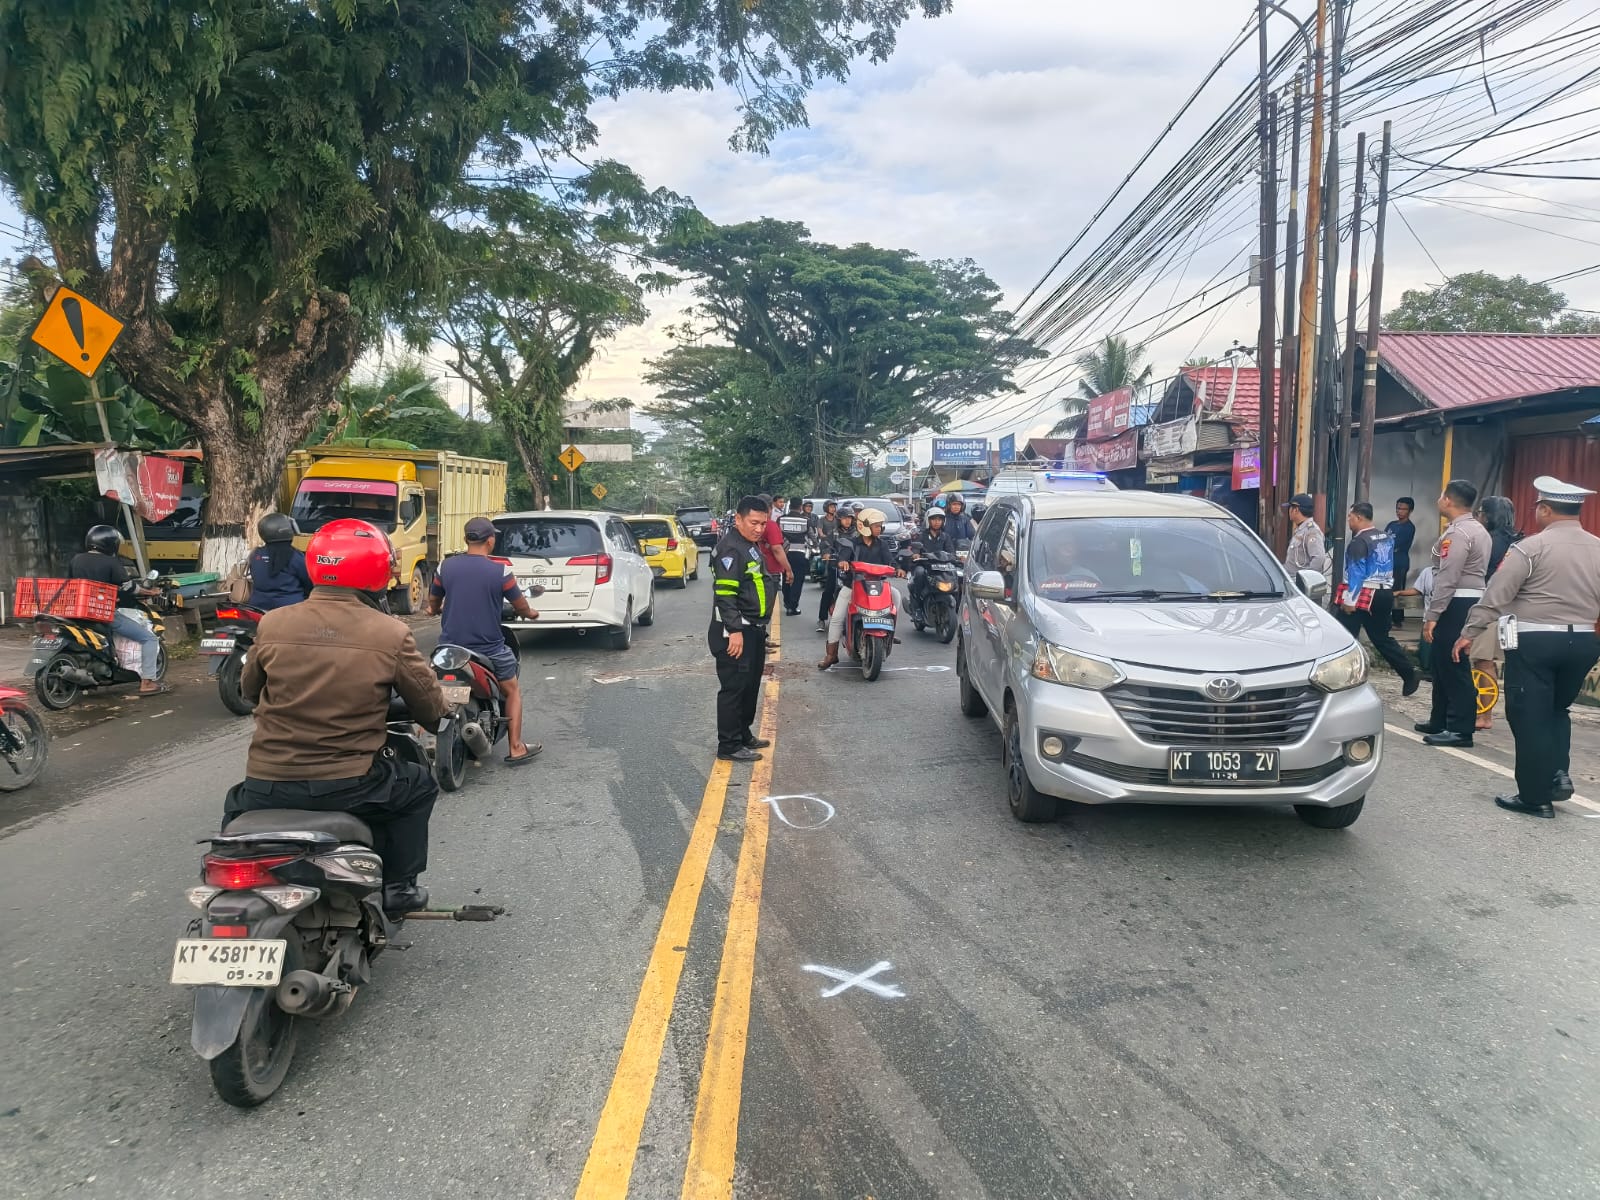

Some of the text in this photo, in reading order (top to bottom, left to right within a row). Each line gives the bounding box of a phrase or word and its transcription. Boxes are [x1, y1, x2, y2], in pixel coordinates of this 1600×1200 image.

[936, 440, 984, 450] Hannochs
[317, 555, 345, 566] KYT
[1173, 752, 1274, 771] KT 1053 ZV
[179, 945, 279, 963] KT 4581 YK
